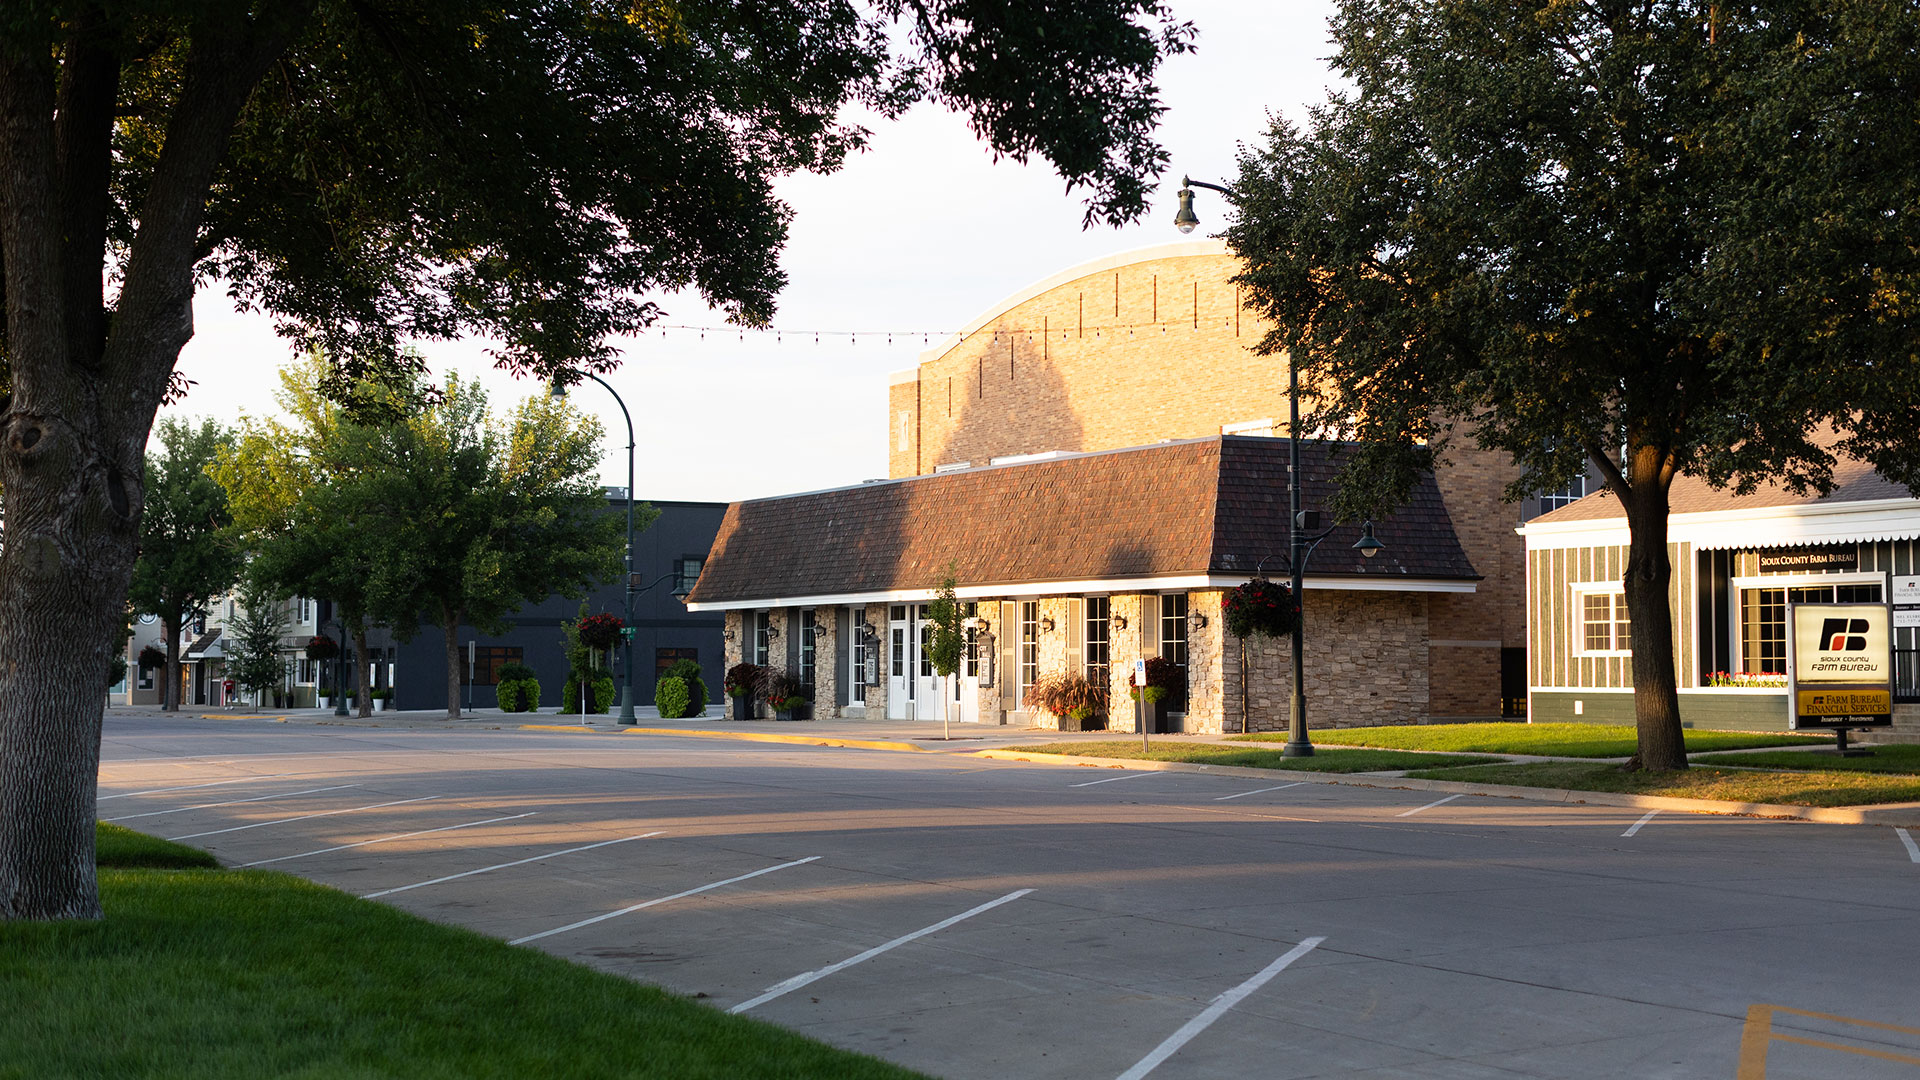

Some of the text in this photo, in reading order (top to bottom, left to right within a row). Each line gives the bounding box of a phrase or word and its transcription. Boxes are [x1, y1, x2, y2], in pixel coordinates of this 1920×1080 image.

[1761, 553, 1855, 566] SIOUX COUNTY FARM BUREAU
[1826, 695, 1848, 704] FARM
[1850, 694, 1882, 704] BUREAU
[1806, 703, 1887, 714] FINANCIAL SERVICES
